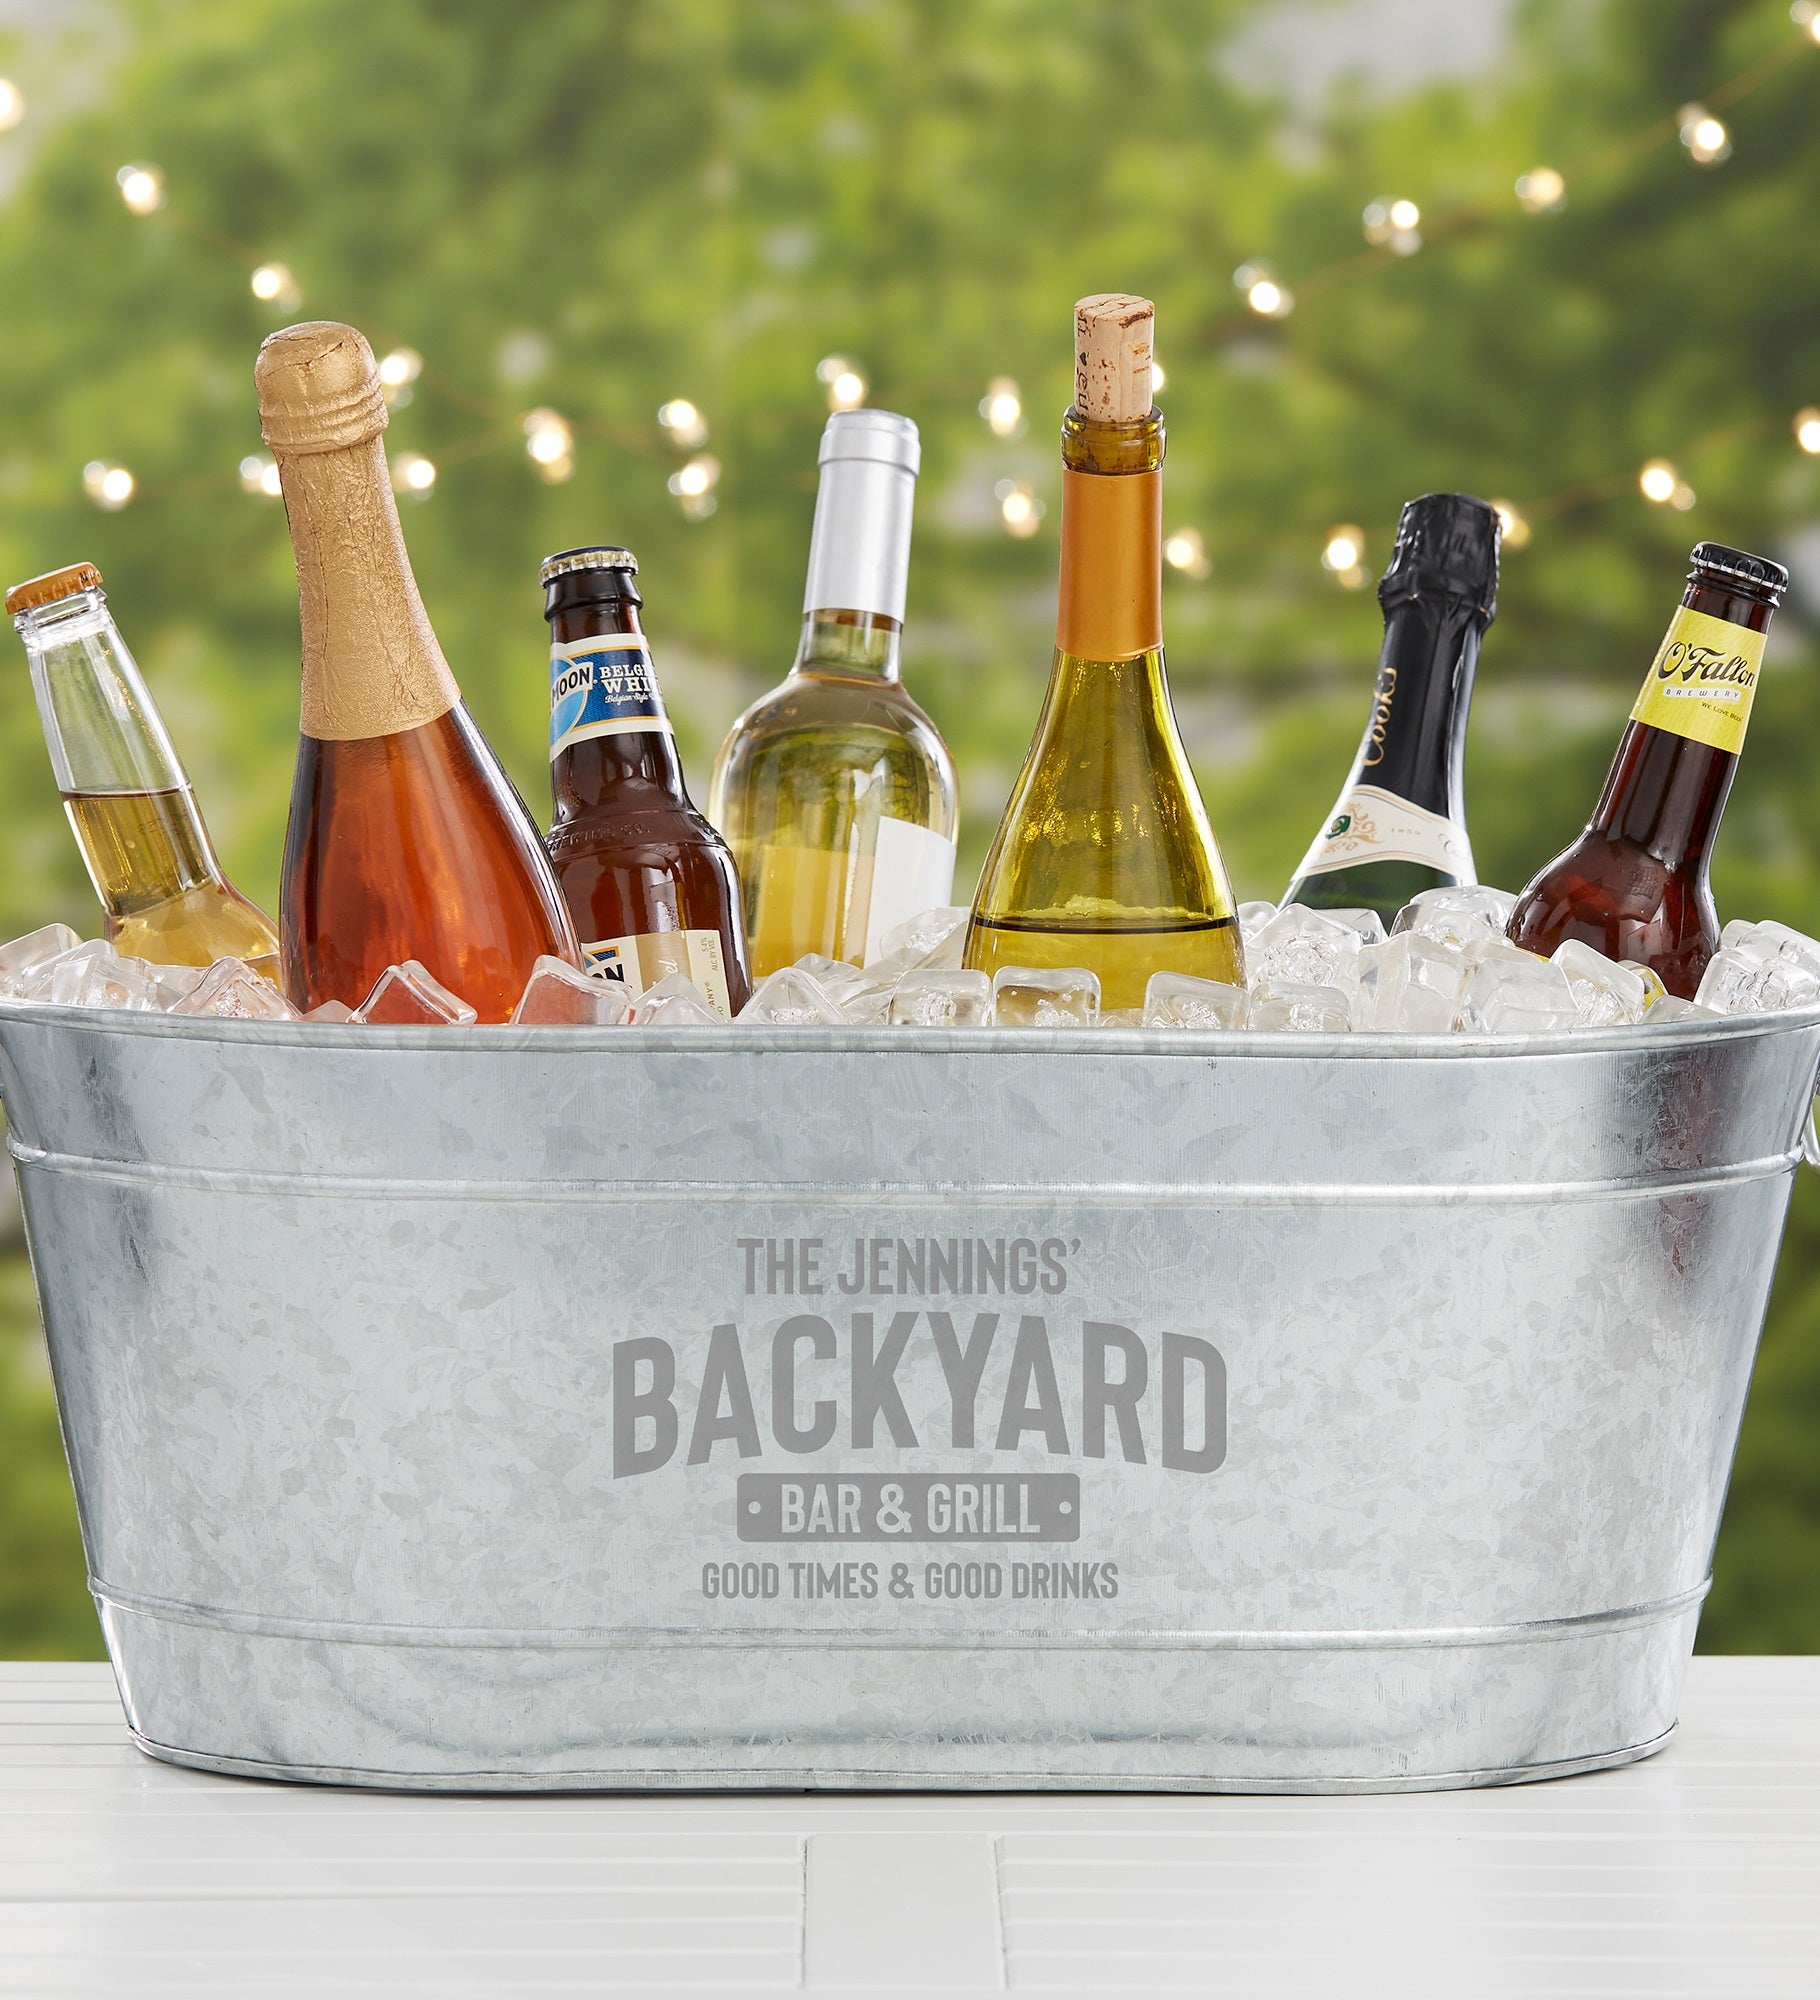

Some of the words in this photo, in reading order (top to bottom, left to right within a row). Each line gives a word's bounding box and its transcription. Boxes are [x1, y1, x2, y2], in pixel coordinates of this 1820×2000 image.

[1658, 641, 1755, 687] O'Fallon
[1666, 688, 1739, 698] BREWERY
[737, 1238, 823, 1295] THE
[837, 1238, 1081, 1295] JENNINGS'
[613, 1311, 1228, 1479] BACKYARD
[781, 1484, 861, 1533] BAR
[876, 1484, 913, 1534] &
[927, 1483, 1040, 1534] GRILL
[702, 1562, 779, 1599] GOOD
[792, 1562, 878, 1599] TIMES
[890, 1562, 916, 1599] &
[925, 1562, 1002, 1599] GOOD
[1012, 1562, 1118, 1599] DRINKS
